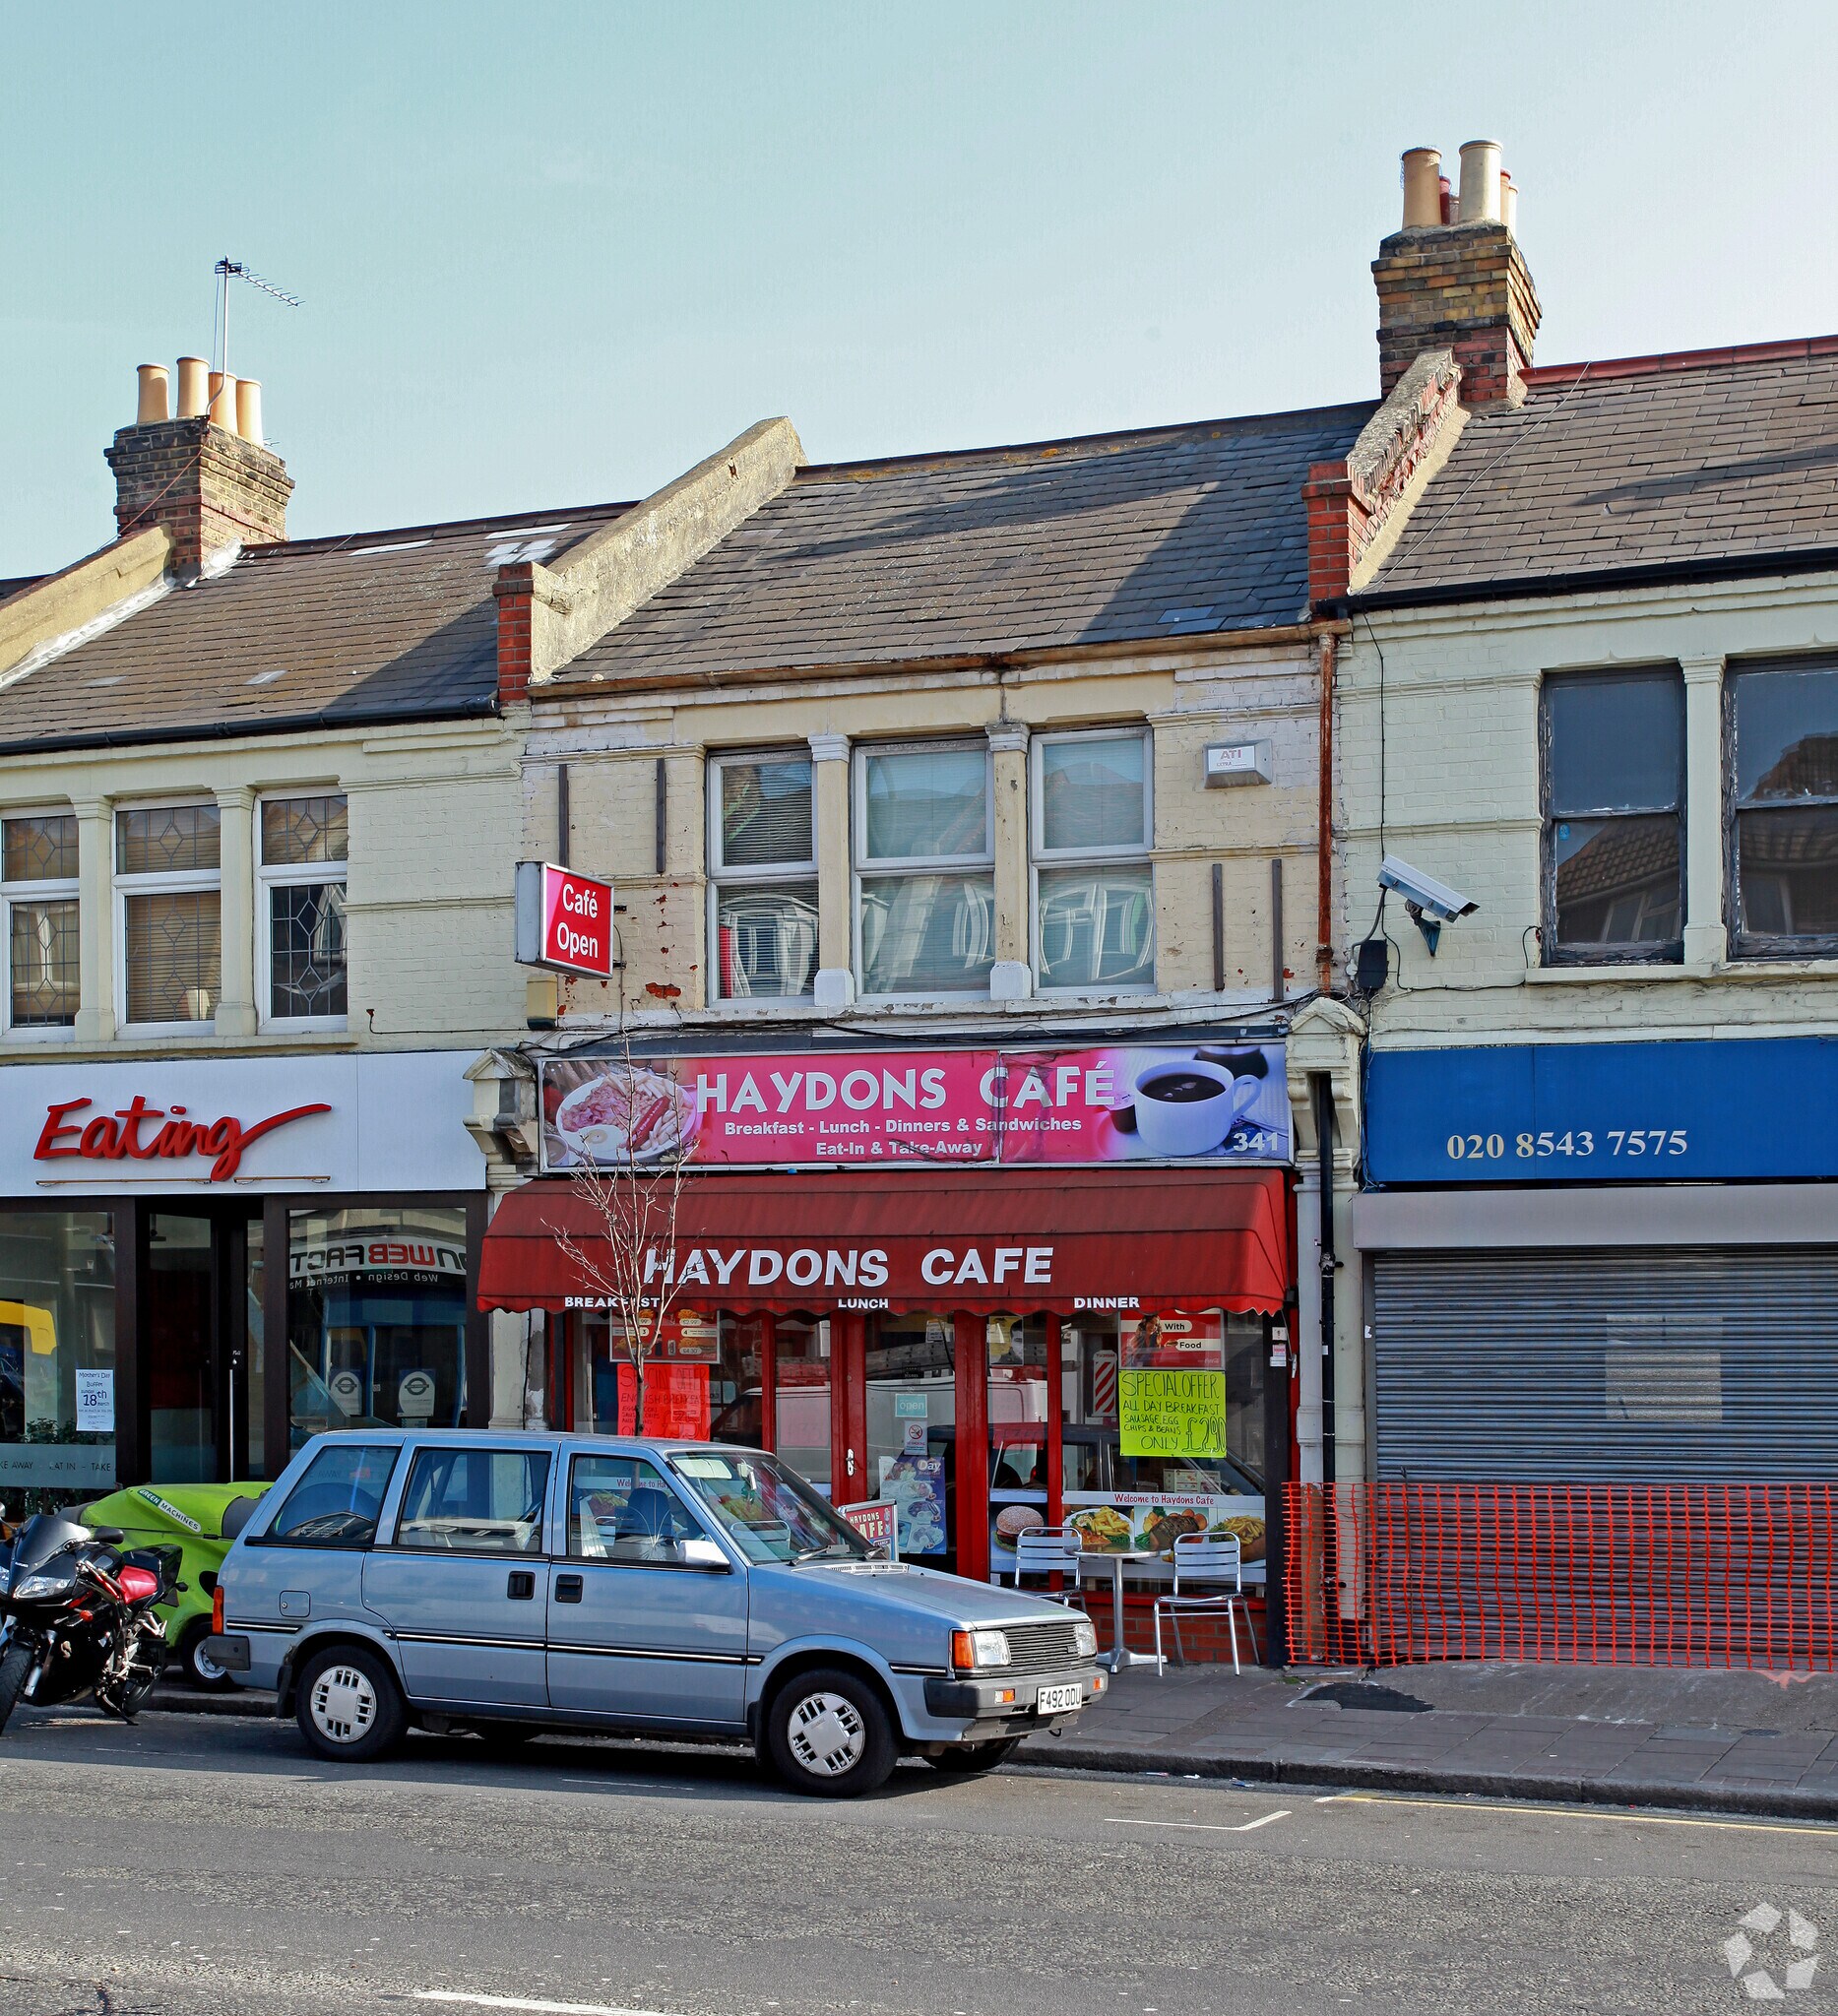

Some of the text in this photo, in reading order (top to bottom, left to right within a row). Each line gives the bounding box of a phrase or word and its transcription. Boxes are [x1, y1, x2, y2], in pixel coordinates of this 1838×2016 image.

[1221, 749, 1242, 760] ATI
[562, 883, 599, 918] Café
[557, 921, 599, 960] Open
[696, 1060, 1115, 1113] HAYDONS CAFÉ
[725, 1120, 804, 1135] Breakfast
[819, 1119, 870, 1134] Lunch
[886, 1117, 951, 1133] Dinners
[956, 1117, 970, 1132] &
[975, 1116, 1082, 1132] Sandwiches
[33, 1095, 333, 1181] Eating
[1233, 1132, 1279, 1152] 341
[1446, 1129, 1688, 1160] 020 8543 7575
[816, 1139, 982, 1157] Eat-In & Take-Away
[643, 1246, 1054, 1288] HAYDONS CAFE
[838, 1297, 889, 1309] LUNCH
[1074, 1296, 1140, 1309] DINNER
[1121, 1372, 1220, 1399] SPECIAL OFFER
[899, 1401, 924, 1412] open
[1122, 1400, 1221, 1416] ALL DAY BREAKFAST
[1162, 1416, 1179, 1425] EGG
[1156, 1426, 1181, 1435] BEANS
[1140, 1435, 1178, 1450] ONLY
[12, 1461, 33, 1470] AWAY
[66, 1462, 76, 1471] IN
[91, 1462, 111, 1472] TAKE
[139, 1488, 160, 1504] GREEN
[1114, 1493, 1214, 1505] Welcome to Haydons Cafe
[159, 1502, 199, 1530] MACHINES
[850, 1512, 880, 1525] HAYDONS
[859, 1520, 884, 1539] AFE
[1040, 1686, 1082, 1711] F492 ODU
